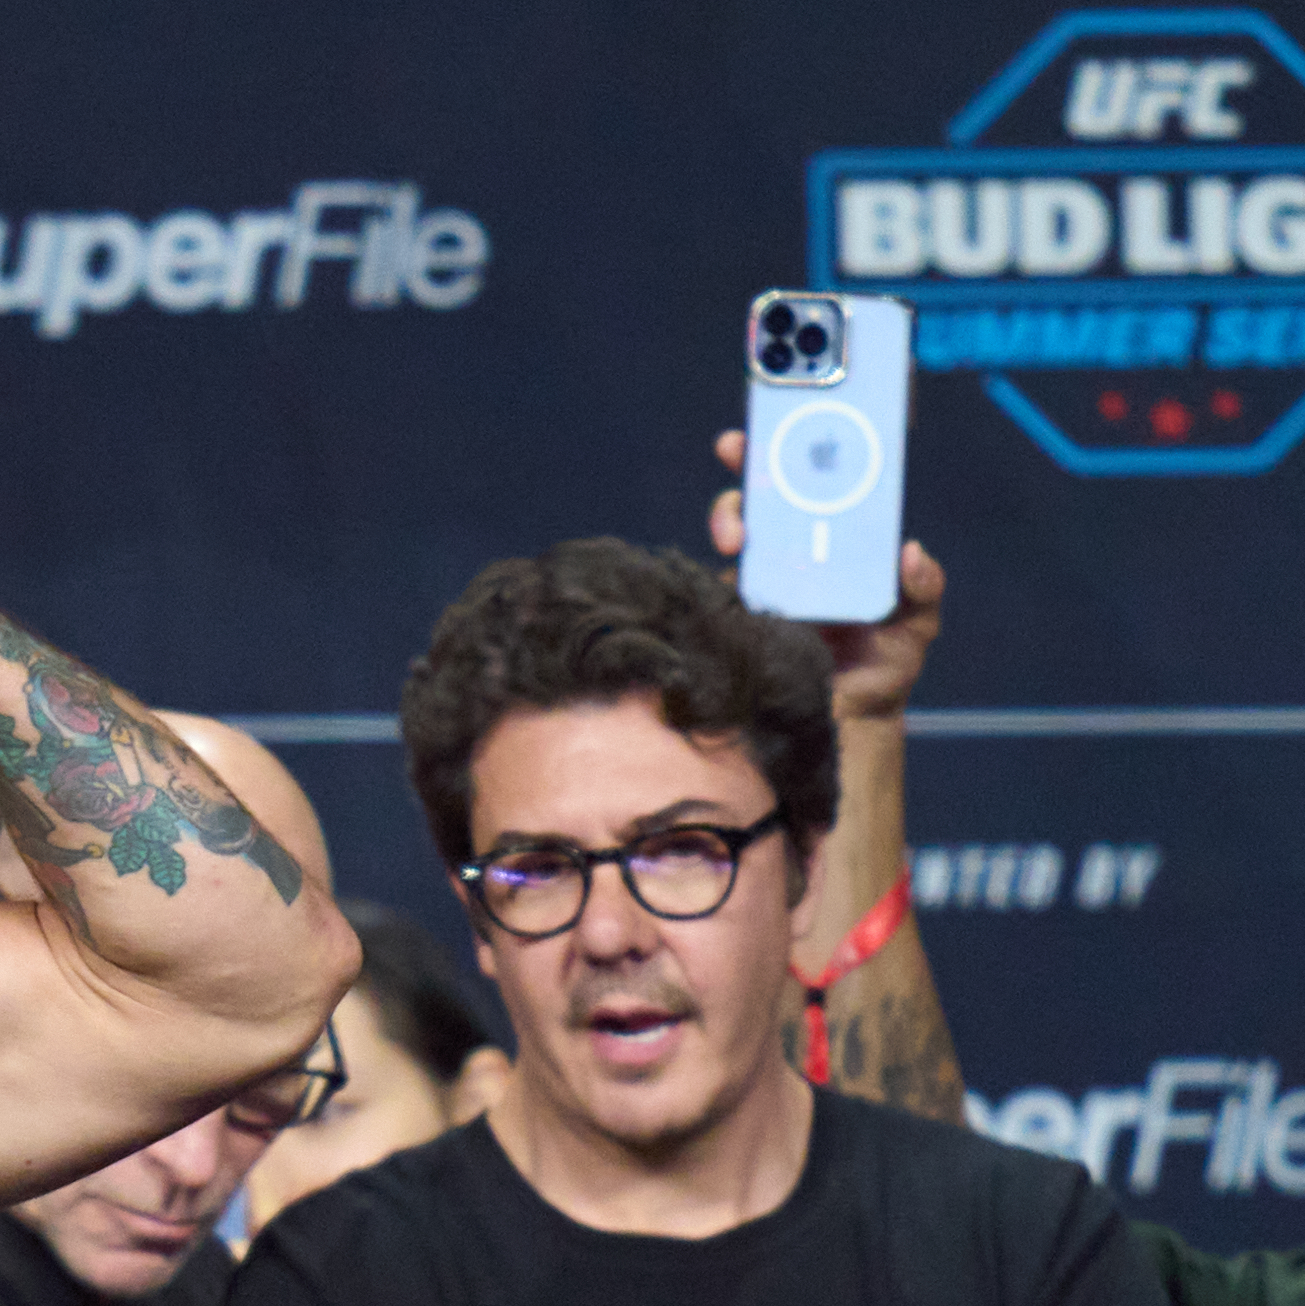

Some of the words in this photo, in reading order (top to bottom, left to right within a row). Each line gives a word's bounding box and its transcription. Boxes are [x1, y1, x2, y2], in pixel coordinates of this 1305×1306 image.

[1065, 57, 1253, 140] UFC
[837, 178, 1110, 276] BUD
[1123, 176, 1305, 276] LIG
[916, 308, 1190, 370] UMMER
[965, 1057, 1305, 1192] erFil
